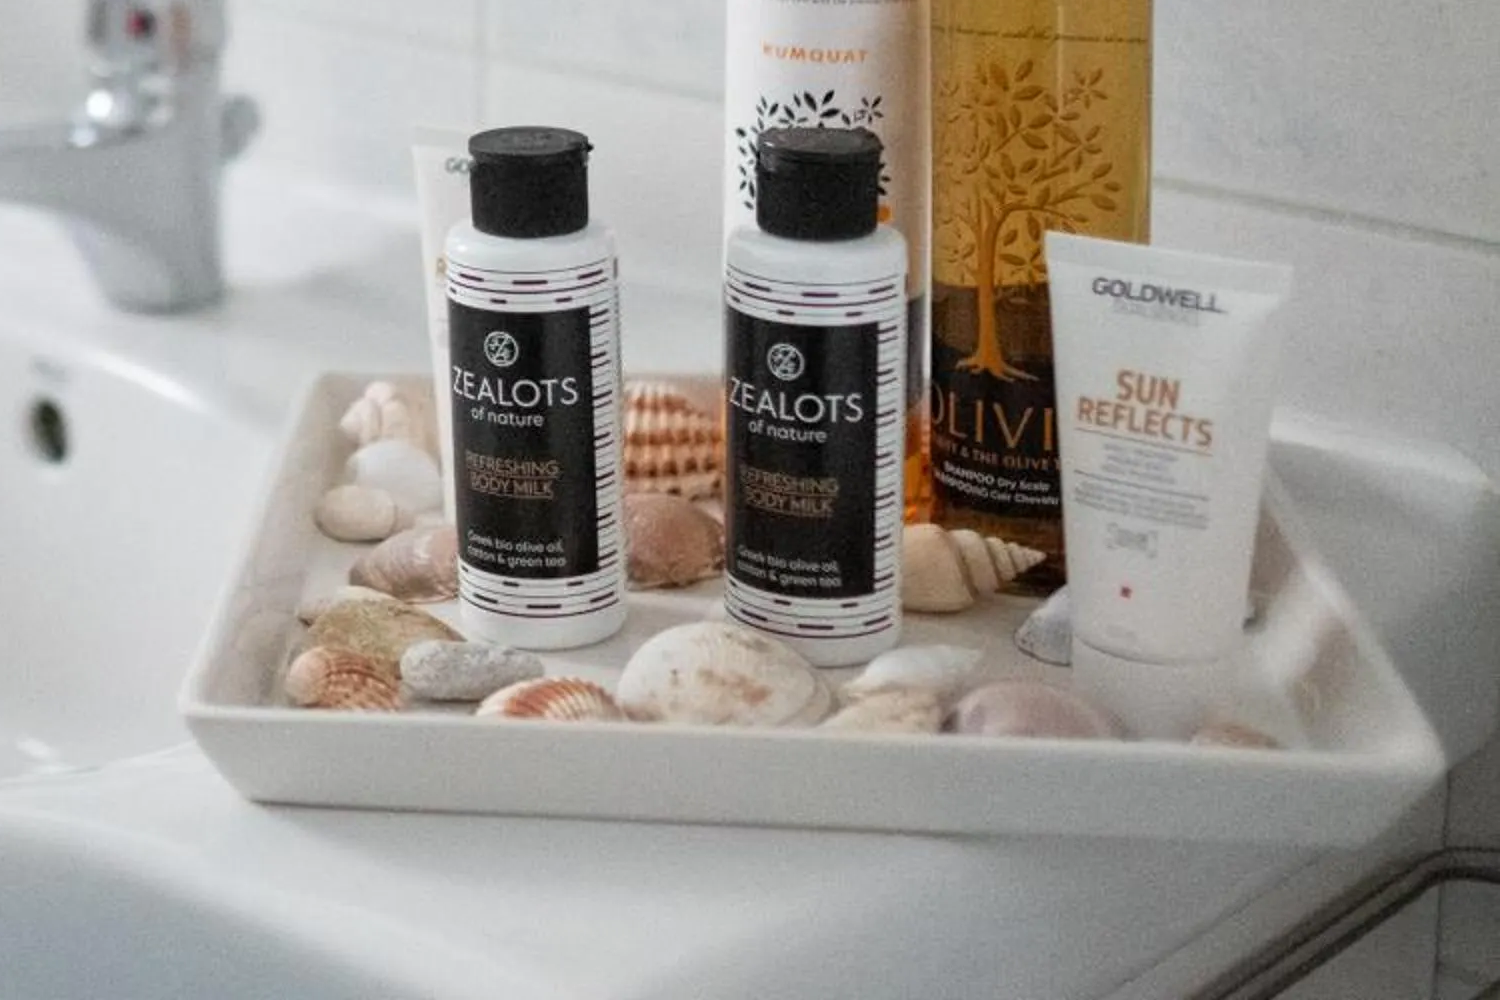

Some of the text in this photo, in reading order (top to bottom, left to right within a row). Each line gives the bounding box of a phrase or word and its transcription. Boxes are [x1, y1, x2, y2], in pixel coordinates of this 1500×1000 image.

[762, 42, 869, 64] KUMQUAT
[1092, 276, 1228, 315] GOLDWELL
[452, 365, 579, 408] ZEALOTS
[729, 375, 864, 424] ZEALOTS
[1116, 368, 1180, 411] SUN
[470, 405, 544, 427] of nature
[1077, 395, 1214, 447] REFLECTS
[748, 419, 828, 444] of nature
[466, 450, 559, 476] REFRESHING
[471, 471, 553, 497] BODY MILK
[495, 538, 513, 551] bio
[515, 541, 545, 553] olive
[507, 556, 543, 568] green
